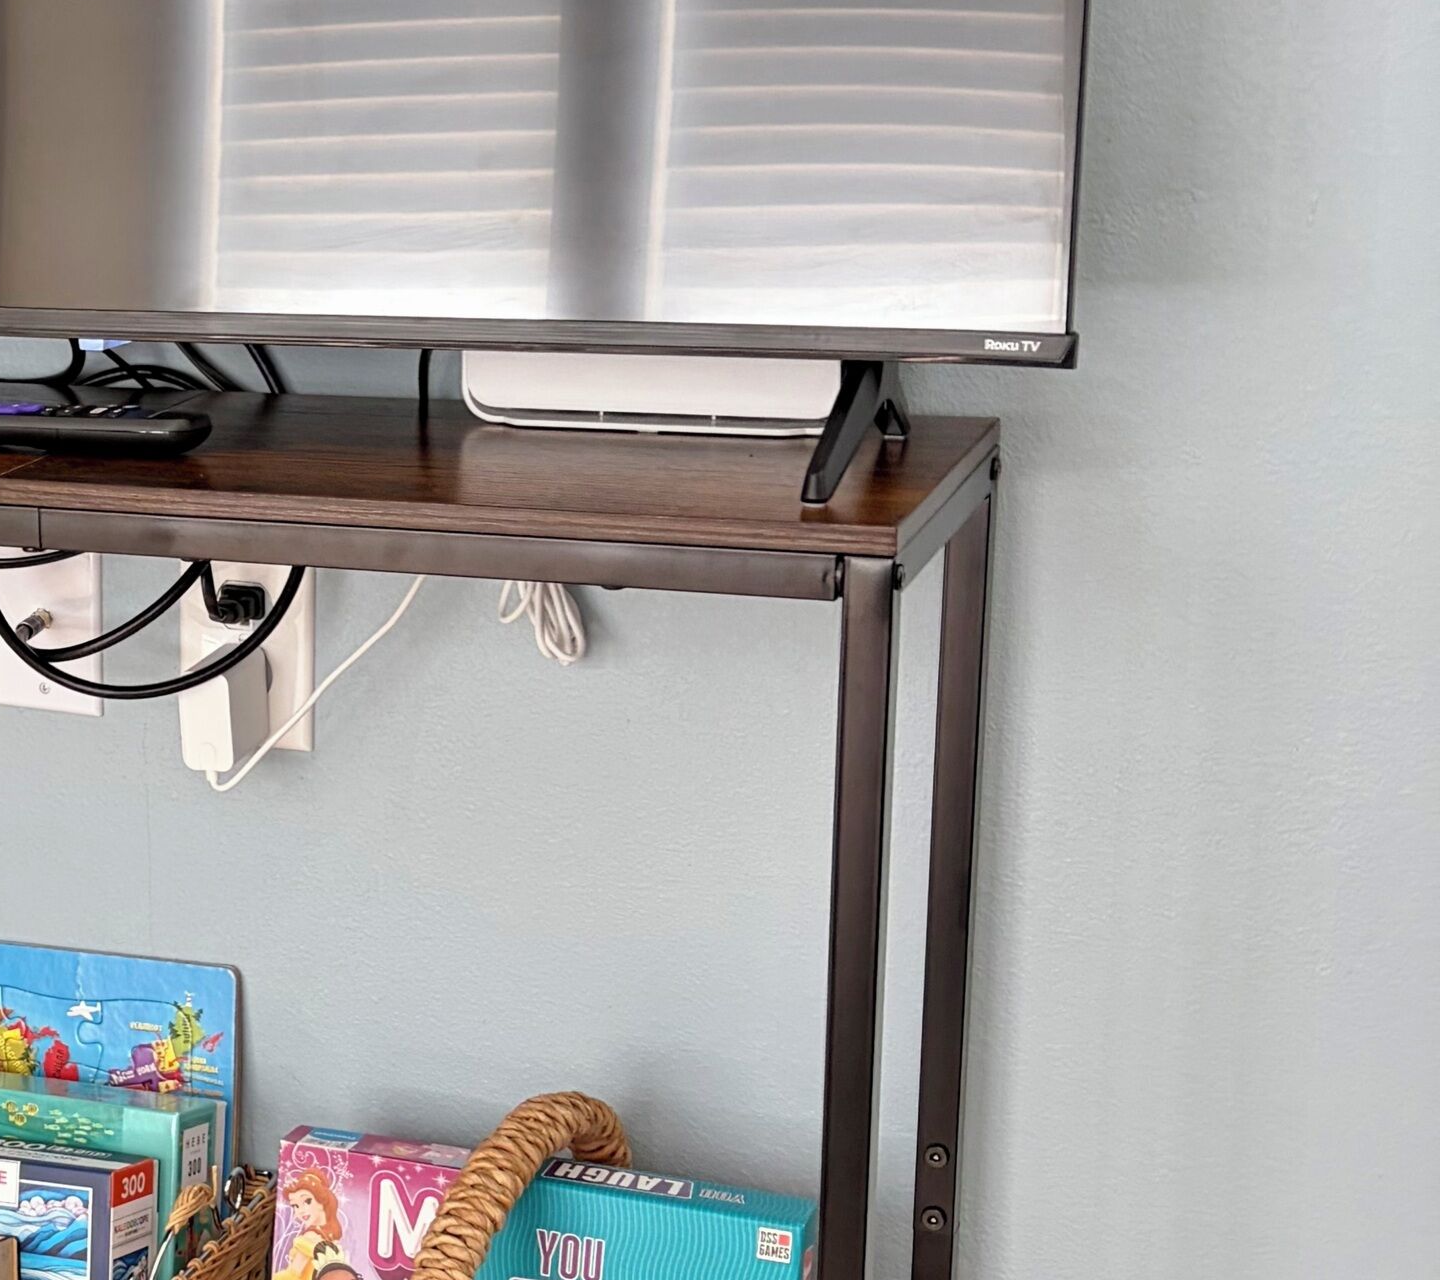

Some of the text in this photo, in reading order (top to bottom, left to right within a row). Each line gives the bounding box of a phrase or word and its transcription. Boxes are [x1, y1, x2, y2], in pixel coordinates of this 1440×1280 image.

[984, 339, 1042, 352] Roku TV
[120, 1171, 146, 1199] 300
[554, 1162, 684, 1196] LAUGH
[759, 1243, 790, 1260] GAMES
